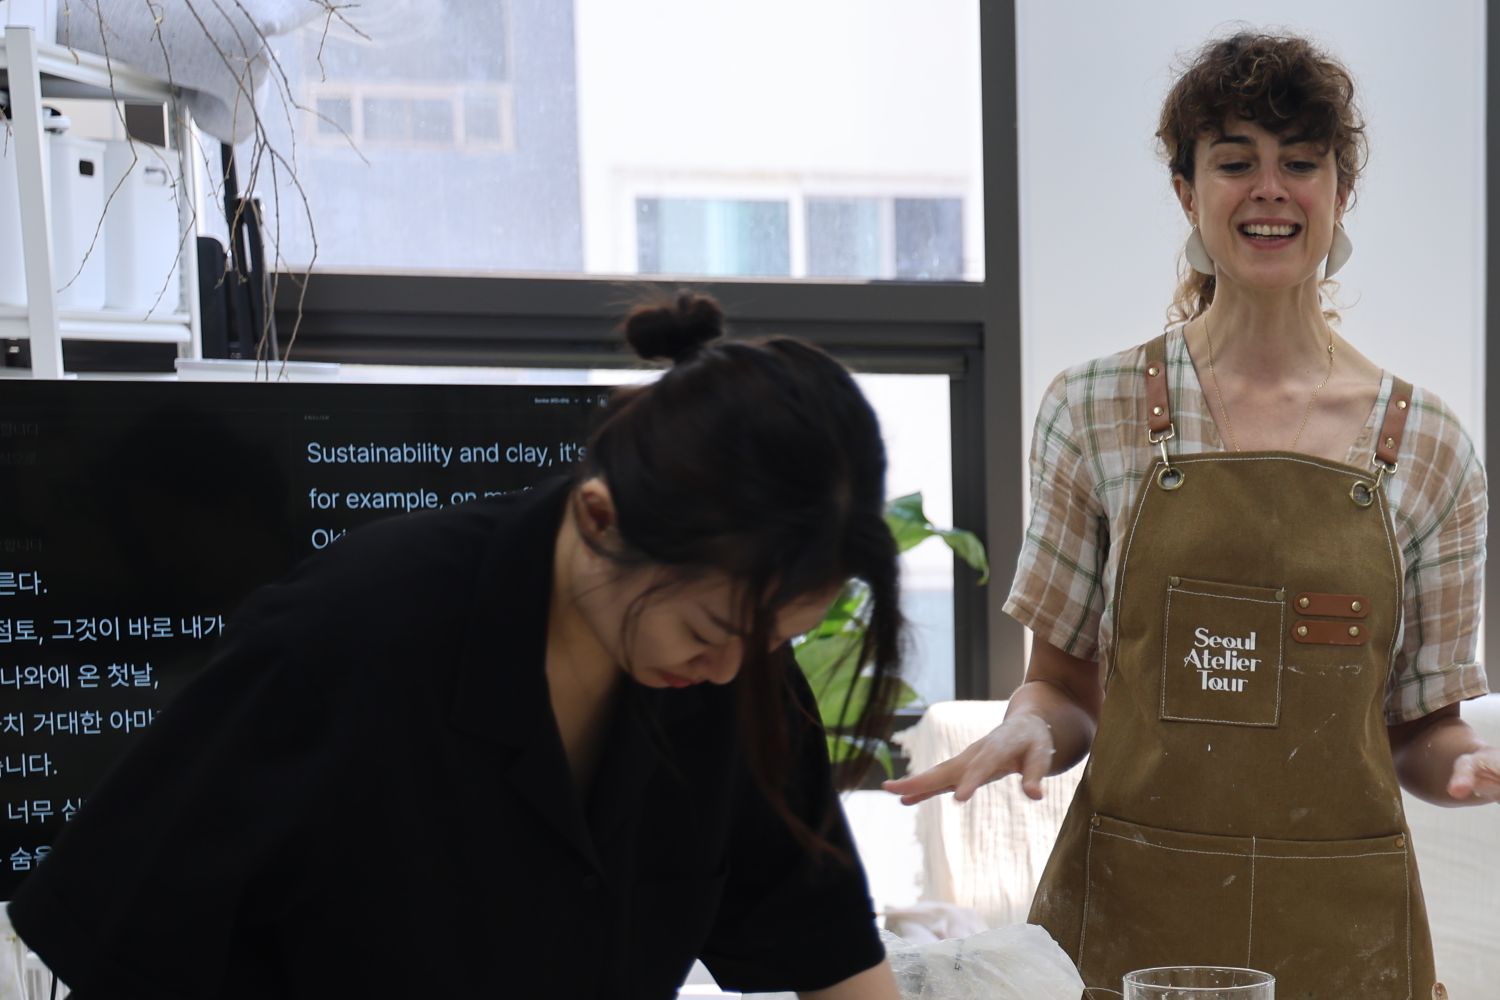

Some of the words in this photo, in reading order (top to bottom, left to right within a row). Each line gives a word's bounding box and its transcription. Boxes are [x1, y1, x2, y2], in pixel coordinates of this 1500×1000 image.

[307, 441, 453, 468] Sustainability
[459, 442, 500, 464] and
[505, 442, 553, 468] clay,
[308, 487, 341, 510] for
[345, 487, 444, 513] example,
[51, 616, 120, 642] 그것이
[128, 615, 174, 641] 바로
[181, 614, 226, 640] 내가
[1194, 627, 1256, 650] Seoul
[1184, 648, 1262, 672] Atelier
[0, 663, 70, 690] 나와에
[77, 664, 101, 689] 온
[107, 661, 159, 690] 첫날,
[1197, 669, 1248, 692] Tour
[33, 709, 103, 736] 거대한
[7, 799, 54, 825] 너무
